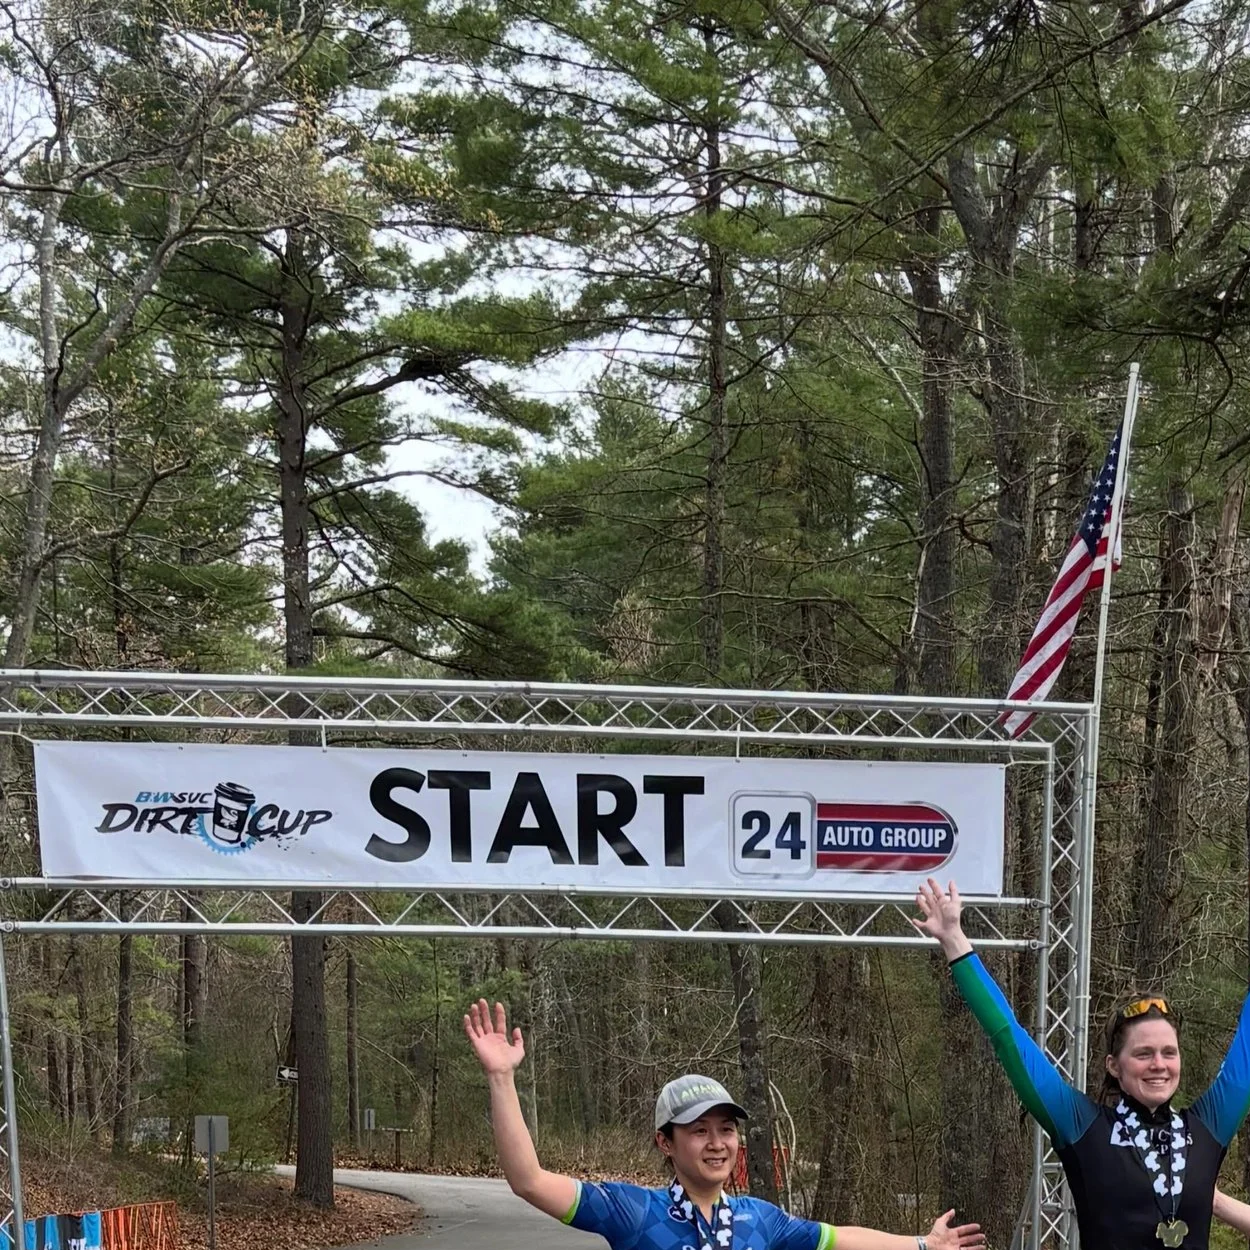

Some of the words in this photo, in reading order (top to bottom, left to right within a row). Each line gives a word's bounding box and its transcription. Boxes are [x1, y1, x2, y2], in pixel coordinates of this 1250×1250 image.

[95, 803, 206, 834] DIRT
[246, 804, 333, 837] CUP
[365, 767, 705, 867] START
[740, 810, 806, 860] 24
[822, 826, 873, 848] AUTO
[879, 827, 947, 849] GROUP
